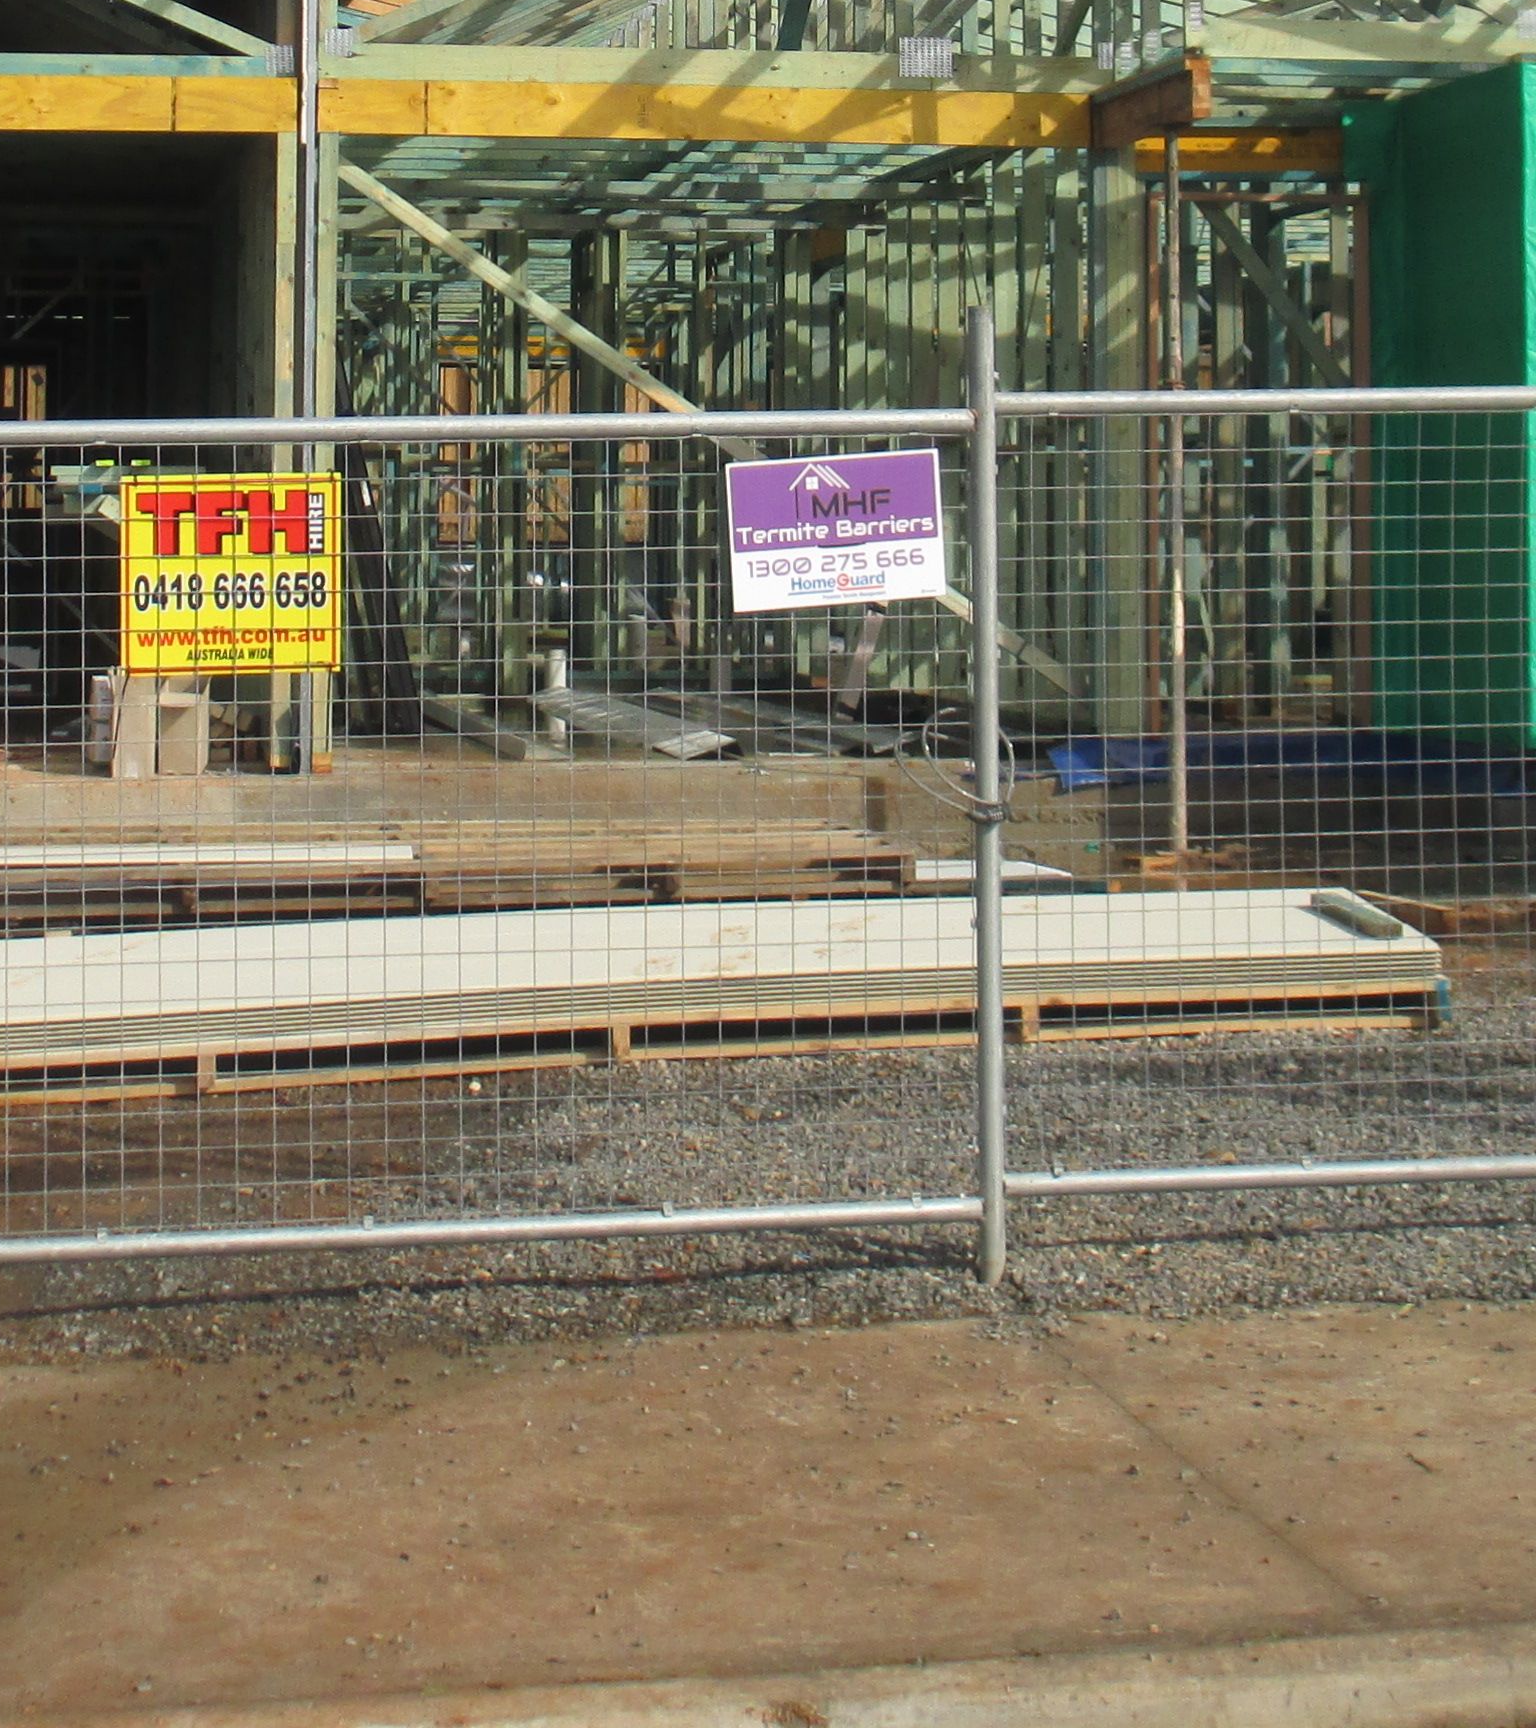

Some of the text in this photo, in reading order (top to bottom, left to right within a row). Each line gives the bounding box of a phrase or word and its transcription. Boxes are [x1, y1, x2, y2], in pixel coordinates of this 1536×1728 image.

[811, 489, 891, 519] MHF
[135, 490, 310, 556] TFH
[309, 493, 324, 551] HIRE
[736, 515, 934, 545] Termite Barriers
[747, 548, 925, 578] 1300 275 666
[134, 571, 326, 611] 0418 666 658
[790, 571, 886, 591] HomeGuard
[137, 626, 326, 648] www.tfh.com.au
[186, 647, 274, 661] AUSTRALIA WIDE
